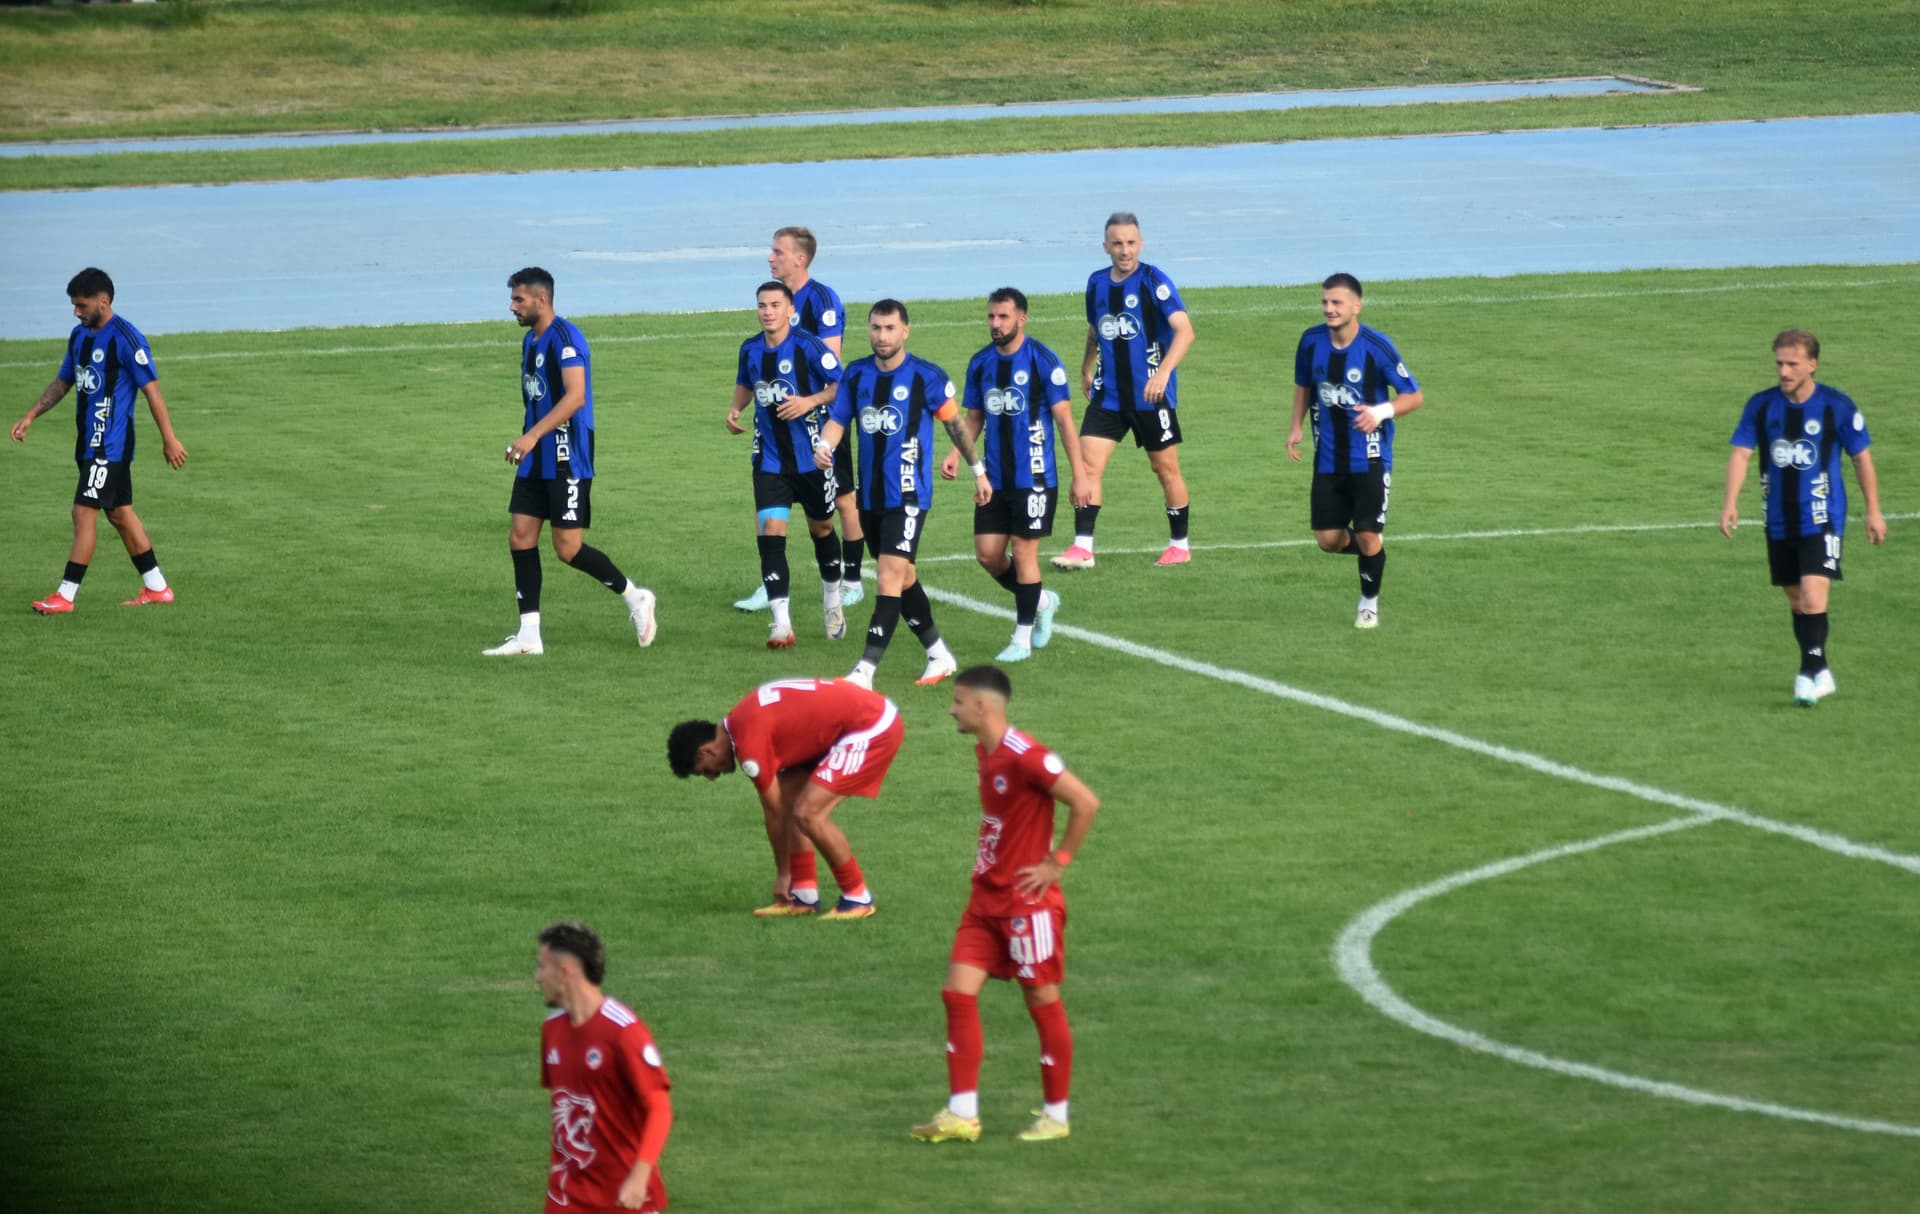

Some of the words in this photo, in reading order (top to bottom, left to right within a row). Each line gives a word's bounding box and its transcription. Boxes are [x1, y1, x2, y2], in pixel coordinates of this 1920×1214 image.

[986, 391, 1020, 410] erk
[90, 396, 108, 447] IDEAL
[861, 410, 897, 430] erk
[1158, 409, 1170, 430] 8
[1028, 420, 1044, 474] IDEAL
[1366, 431, 1380, 459] IDE
[88, 465, 108, 489] 19
[900, 437, 916, 493] IDEAL
[567, 485, 578, 509] 2
[1811, 472, 1828, 525] IDEAL
[904, 516, 916, 541] 9
[1009, 936, 1035, 965] 41
